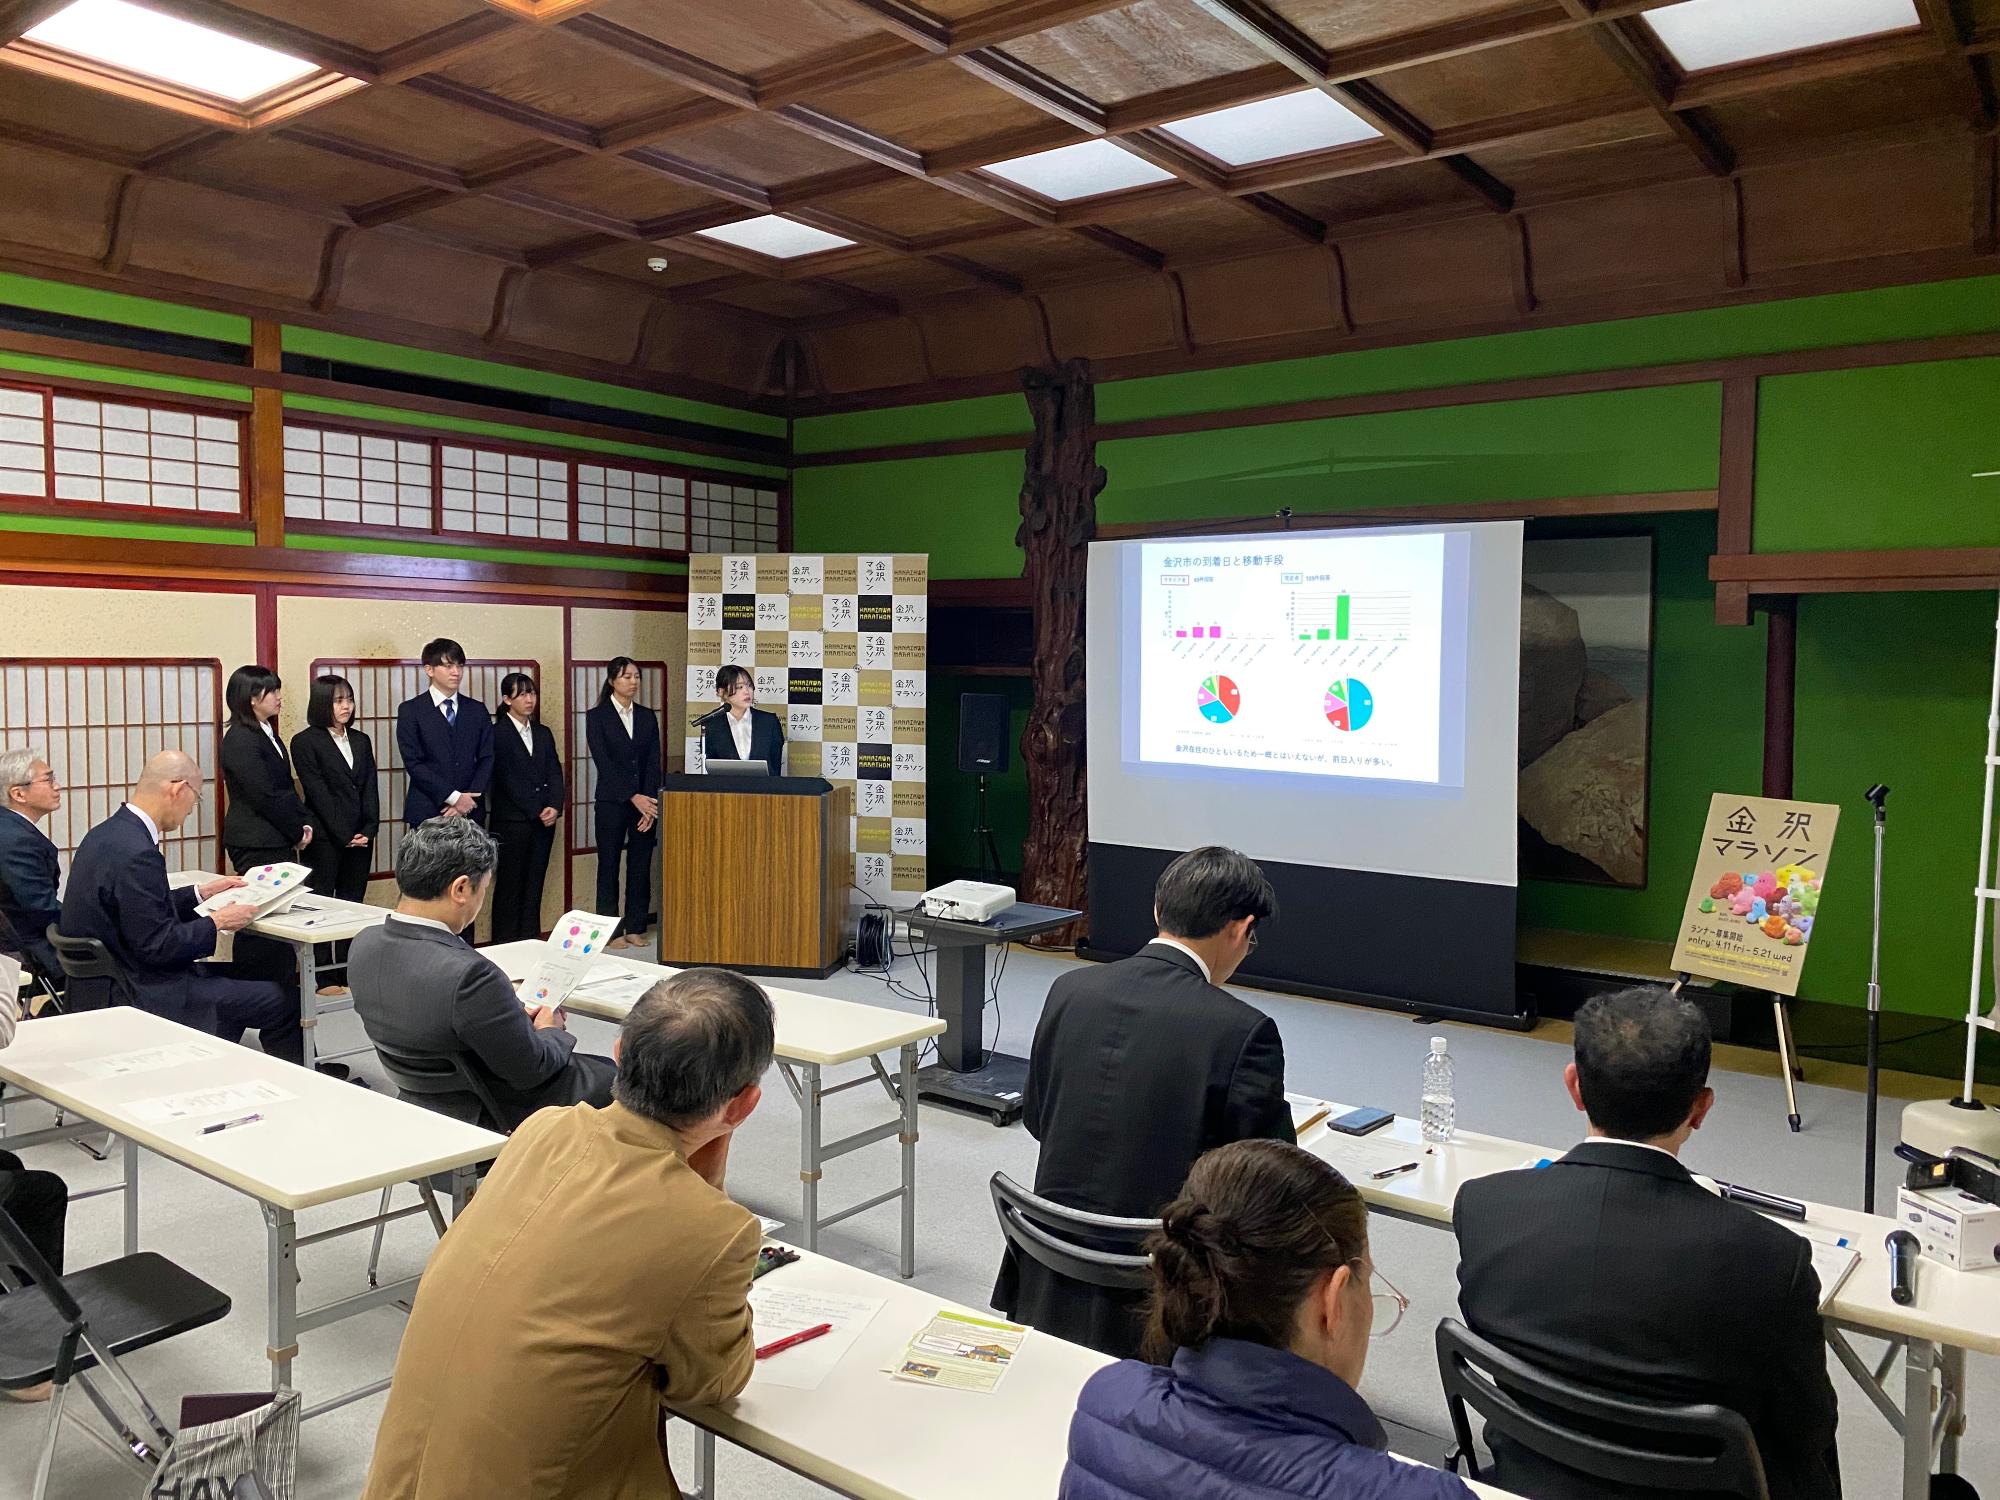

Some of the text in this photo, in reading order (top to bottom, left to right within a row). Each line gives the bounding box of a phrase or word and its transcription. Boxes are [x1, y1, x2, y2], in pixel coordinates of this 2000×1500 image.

[740, 561, 749, 581] 金沢
[792, 566, 810, 575] 金沢
[875, 561, 886, 581] 金沢
[1163, 555, 1284, 568] 金沢市の到着日と移動手段
[730, 561, 738, 589] マラソン
[866, 561, 874, 590] マラソン
[696, 597, 705, 625] マラソン
[706, 597, 716, 617] 金沢
[758, 603, 776, 612] 金沢
[831, 599, 839, 628] マラソン
[841, 598, 851, 618] 金沢
[895, 604, 915, 613] 金沢
[729, 634, 737, 662] マラソン
[738, 634, 748, 653] 金沢
[791, 640, 810, 649] 金沢
[866, 636, 874, 665] マラソン
[875, 636, 885, 656] 金沢
[696, 669, 704, 698] マラソン
[706, 669, 715, 689] 金沢
[757, 676, 775, 685] 金沢
[831, 672, 839, 701] マラソン
[841, 672, 851, 693] 金沢
[895, 680, 915, 688] 金沢
[790, 714, 809, 722] 金沢
[866, 711, 874, 739] マラソン
[875, 711, 885, 730] 金沢
[840, 746, 851, 766] 金沢
[895, 753, 914, 762] 金沢
[865, 784, 873, 813] マラソン
[874, 784, 885, 804] 金沢
[894, 827, 914, 836] 金沢
[1726, 806, 1811, 841] 金沢
[1712, 837, 1819, 866] マラソン
[864, 857, 872, 885] マラソン
[874, 857, 884, 877] 金沢
[1690, 924, 1743, 942] ランナー募集開始
[1688, 937, 1712, 946] entry:
[1716, 941, 1731, 949] 4.11
[1733, 944, 1744, 952] fri
[1753, 947, 1771, 958] 5.21
[1773, 954, 1792, 962] wed
